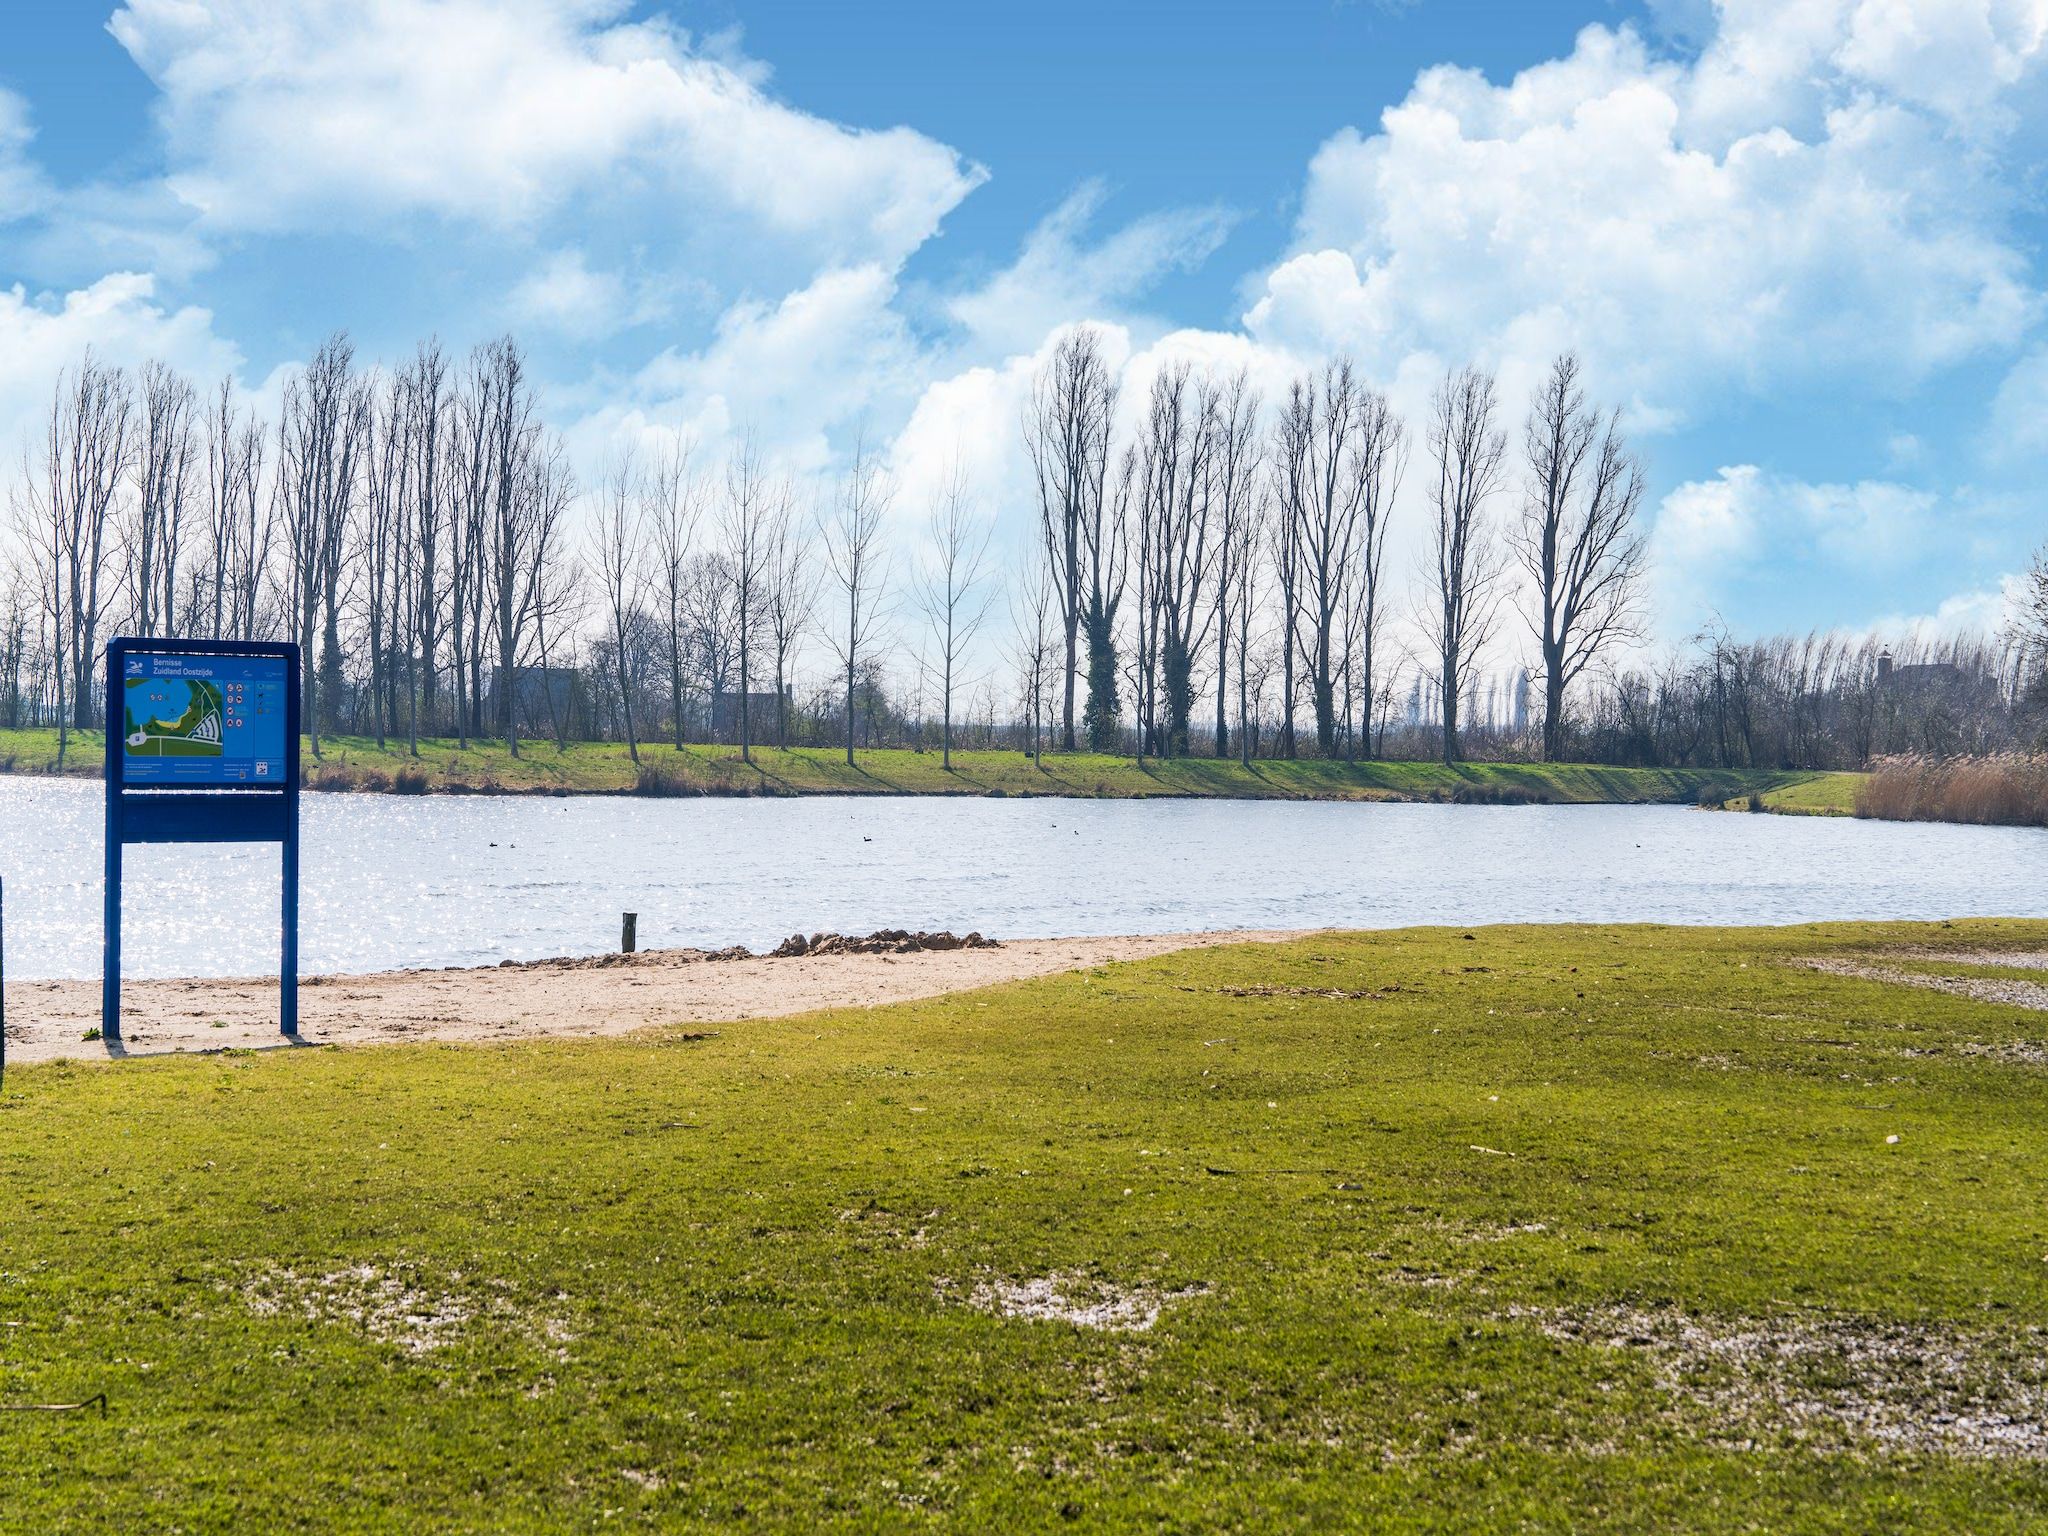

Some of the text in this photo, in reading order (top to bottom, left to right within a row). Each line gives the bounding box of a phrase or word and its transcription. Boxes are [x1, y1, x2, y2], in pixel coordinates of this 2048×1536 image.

[153, 658, 182, 666] Bernisse
[153, 667, 213, 677] Zuidland Oostzijde
